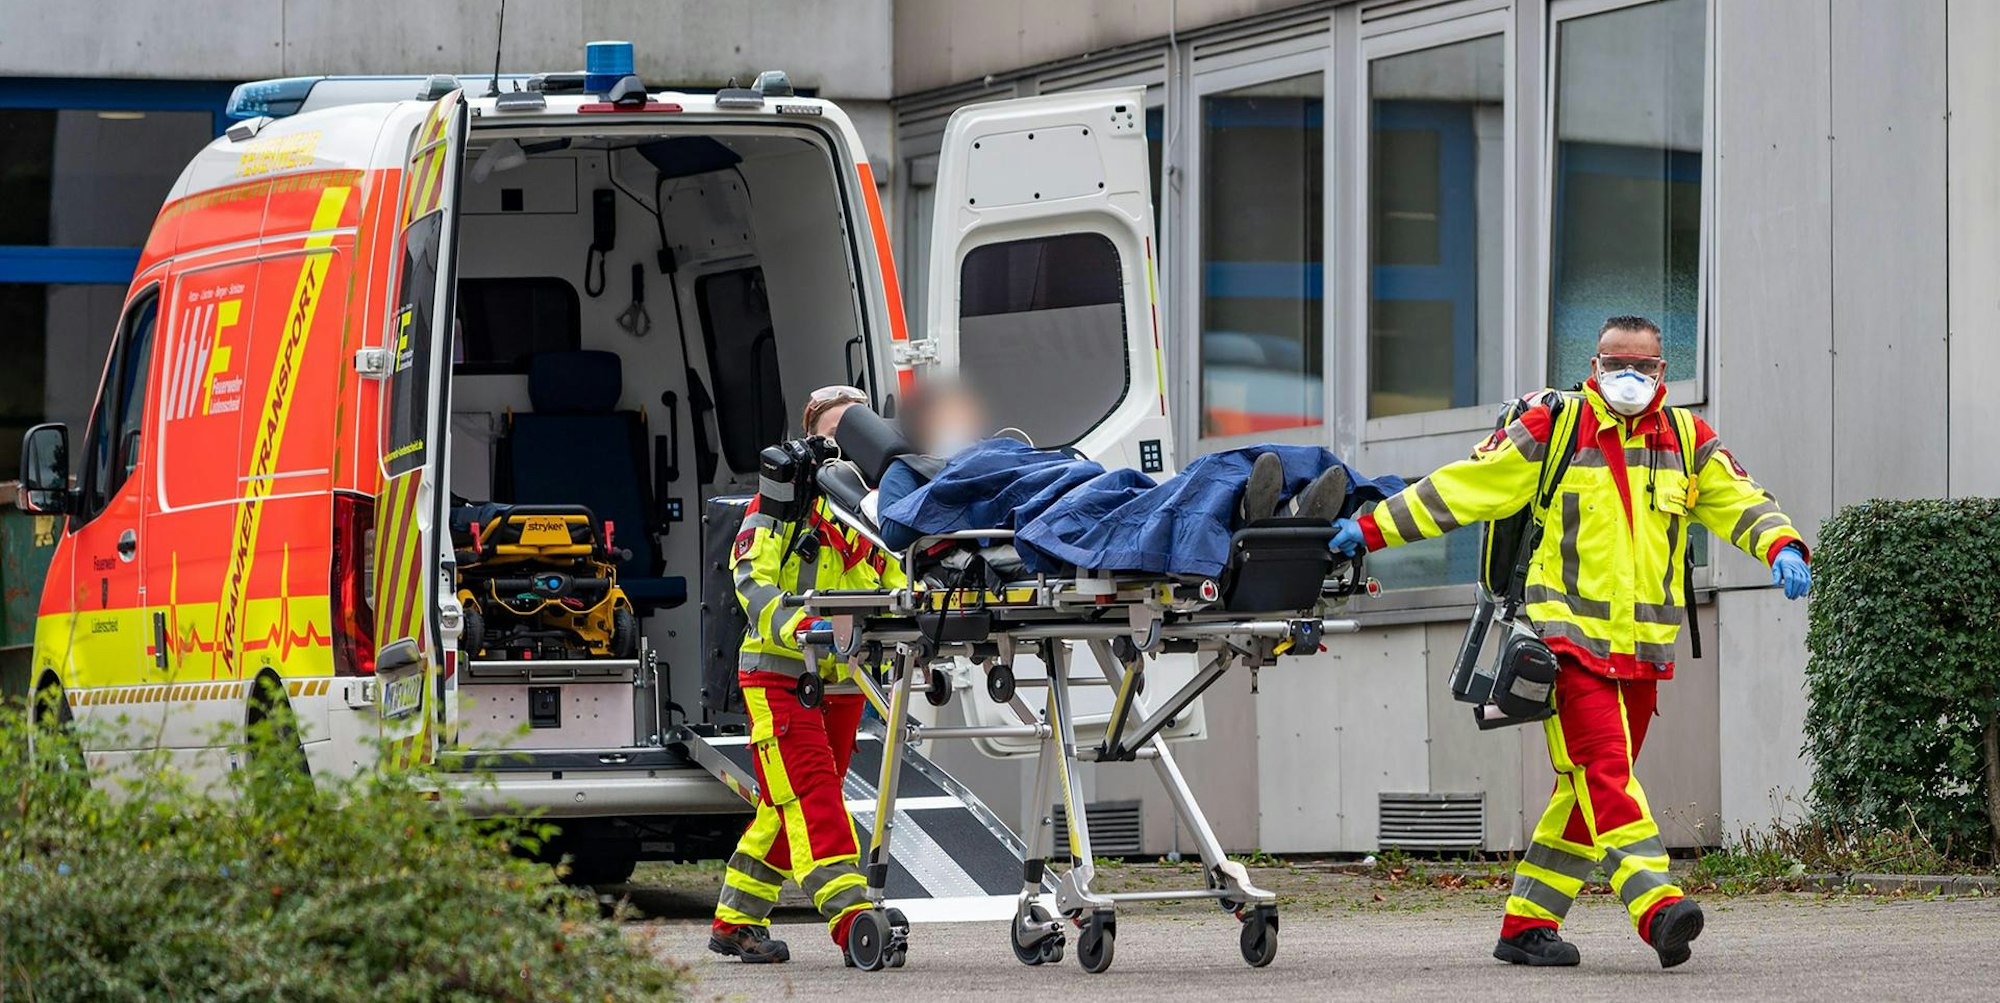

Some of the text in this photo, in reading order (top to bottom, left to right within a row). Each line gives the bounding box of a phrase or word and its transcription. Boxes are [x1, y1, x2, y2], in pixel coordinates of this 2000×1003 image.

[212, 375, 243, 395] Feuerwehr
[222, 259, 317, 676] KRANKENTRANSPORT
[528, 521, 564, 533] stryker
